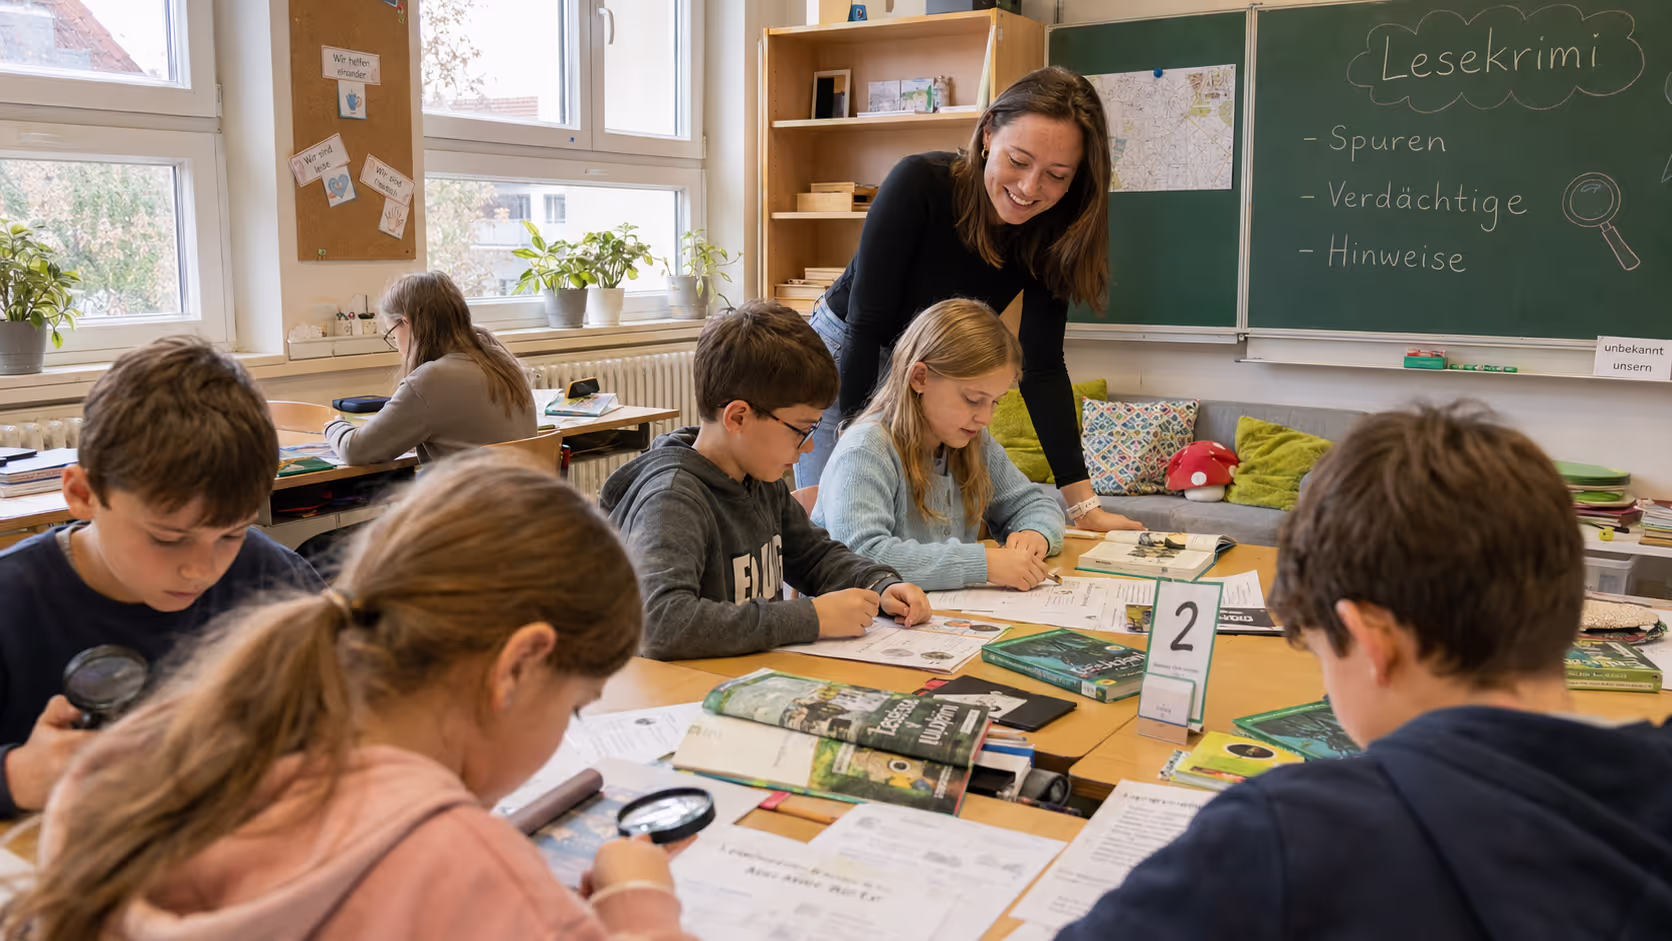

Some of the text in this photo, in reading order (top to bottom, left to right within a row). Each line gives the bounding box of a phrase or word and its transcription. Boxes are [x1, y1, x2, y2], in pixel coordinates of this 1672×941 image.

[333, 53, 346, 63] Wir
[1382, 27, 1599, 81] Lesekrimi
[1328, 124, 1447, 162] Spuren
[303, 154, 316, 165] Wir
[375, 166, 388, 178] Wir
[1328, 180, 1528, 232] Verdächtige
[1328, 233, 1467, 273] Hinweise
[1604, 344, 1664, 356] unbekannt
[1613, 363, 1652, 373] unsern
[1170, 600, 1199, 652] 2
